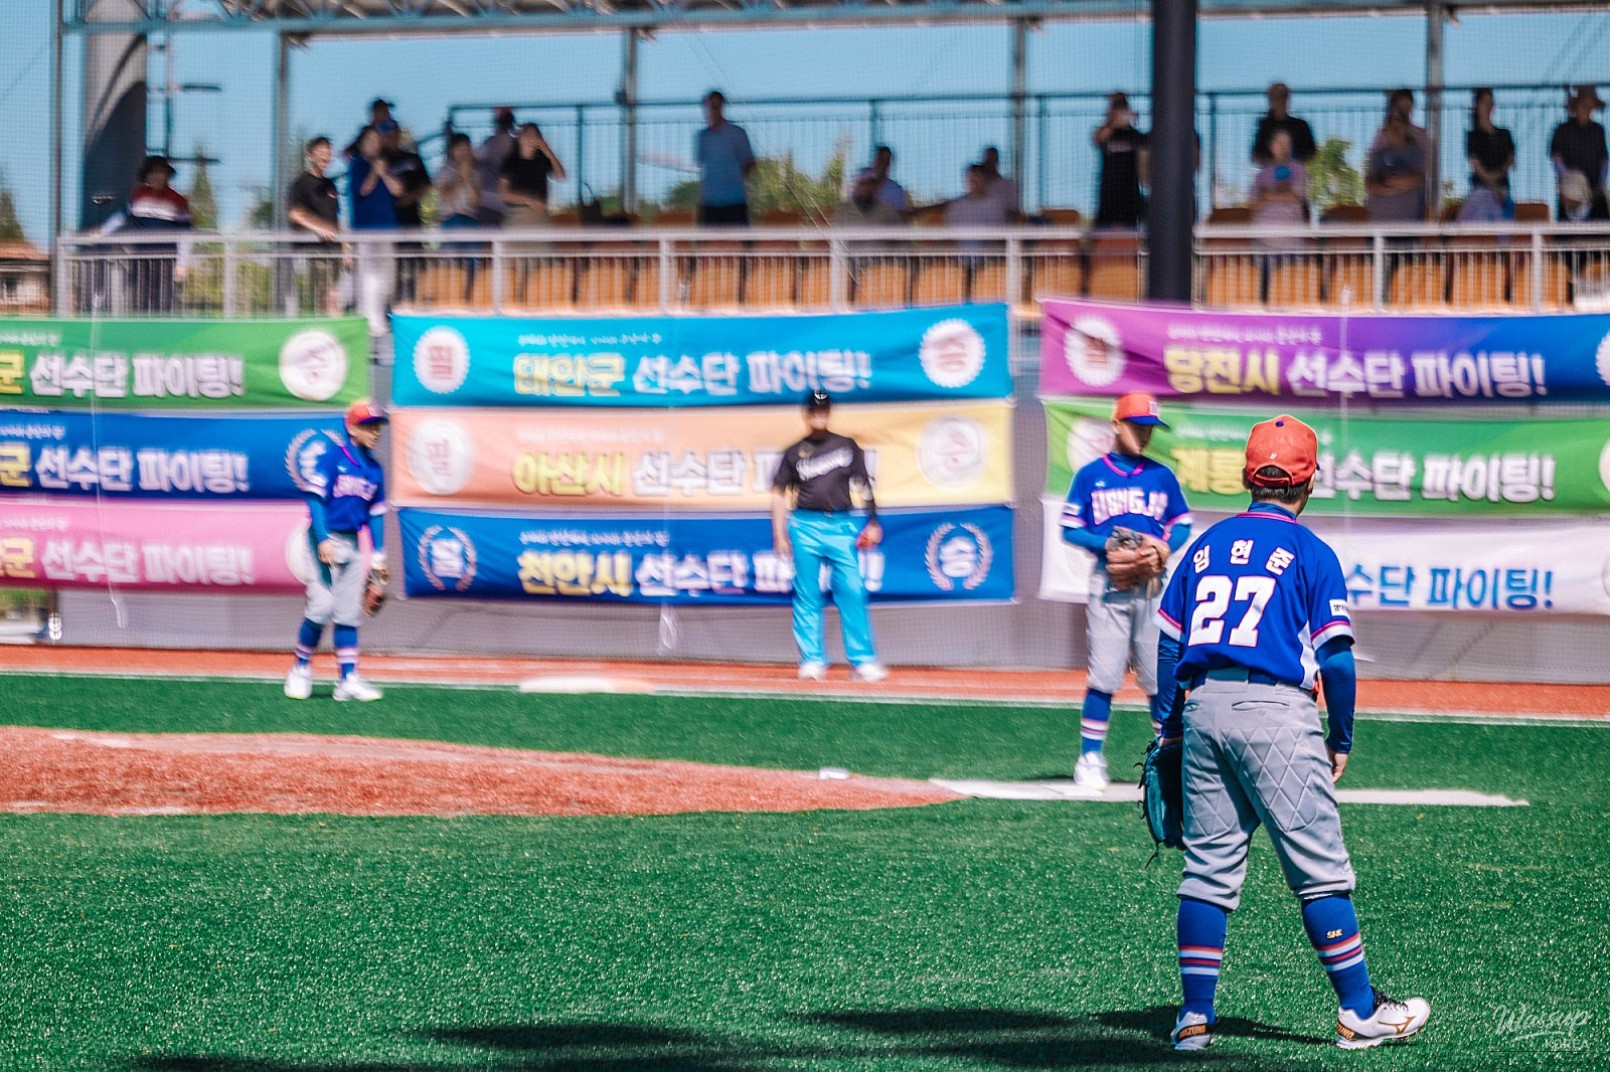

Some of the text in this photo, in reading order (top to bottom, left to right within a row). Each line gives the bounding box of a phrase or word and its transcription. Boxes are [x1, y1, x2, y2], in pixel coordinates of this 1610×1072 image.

[30, 355, 128, 397] 선수단
[132, 354, 243, 398] 파이팅!
[513, 349, 873, 397] 태안군 선수단 파이팅!
[1163, 346, 1547, 398] 당진시 선수단 파이팅!
[0, 442, 31, 487] 군
[36, 446, 134, 491] 선수단
[137, 450, 249, 492] 파이팅!
[512, 452, 624, 496] 아산시
[632, 451, 744, 496] 선수단
[1170, 447, 1246, 496] 계룡
[1422, 452, 1556, 503] 파이팅!
[0, 537, 255, 585] 군 선수단 파이팅!
[516, 549, 632, 596] 천안시
[635, 551, 748, 598] 선수단
[1345, 563, 1554, 610] 수단 파이팅!
[1187, 575, 1276, 647] 27
